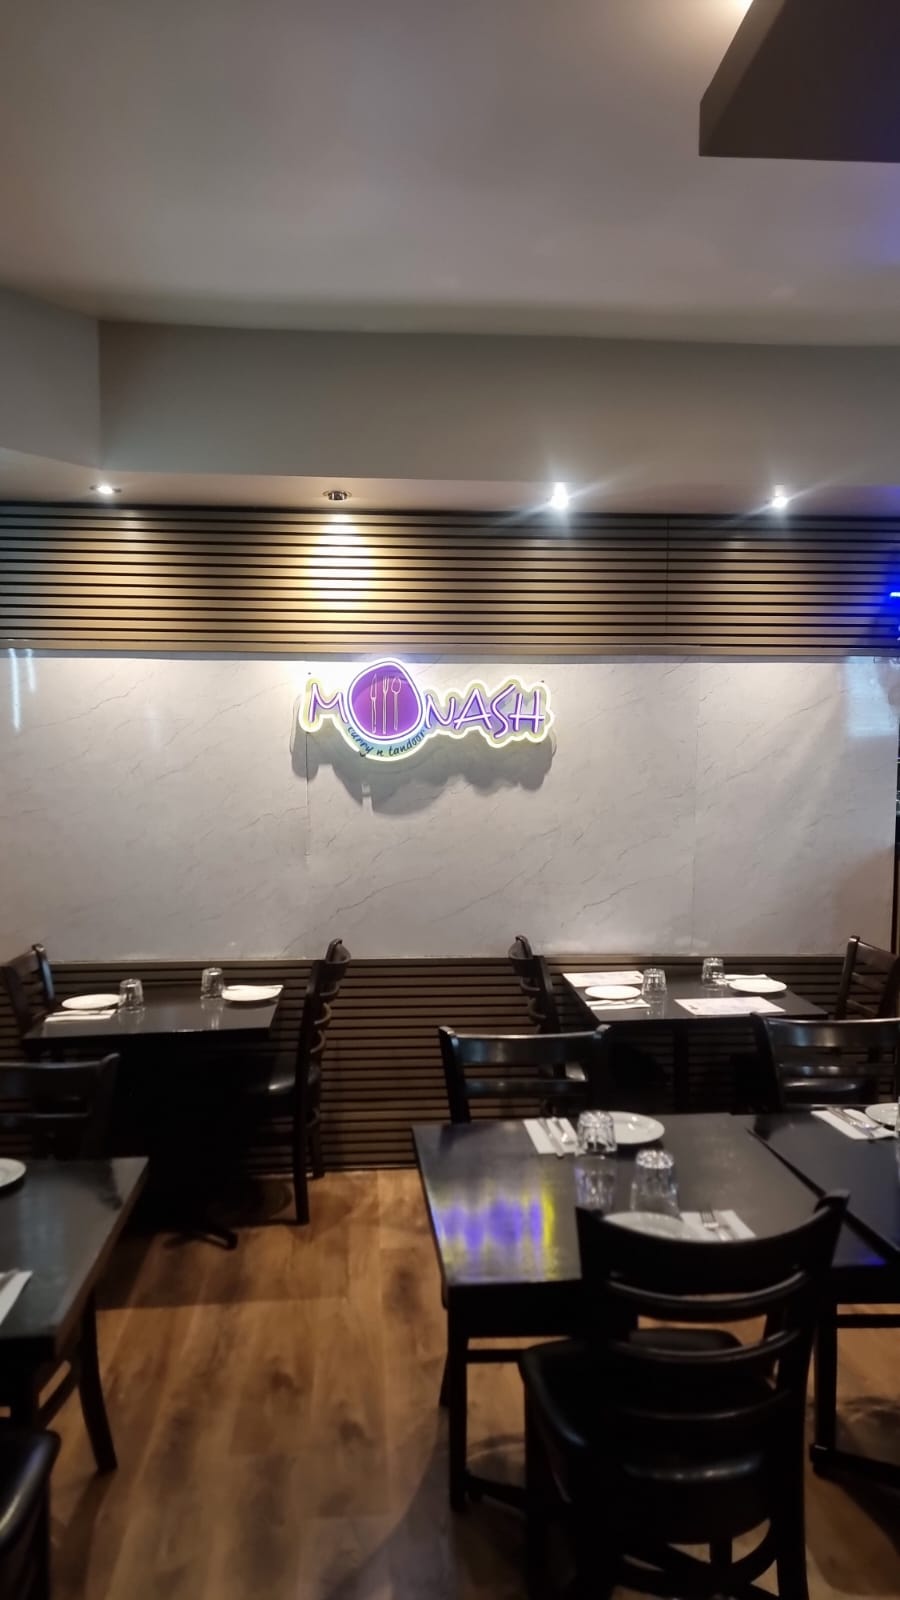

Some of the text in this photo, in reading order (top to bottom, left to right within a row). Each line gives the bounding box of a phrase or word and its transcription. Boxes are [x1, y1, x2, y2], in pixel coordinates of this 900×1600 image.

[307, 660, 546, 740] MONASH
[347, 726, 426, 757] curry n tandoor
